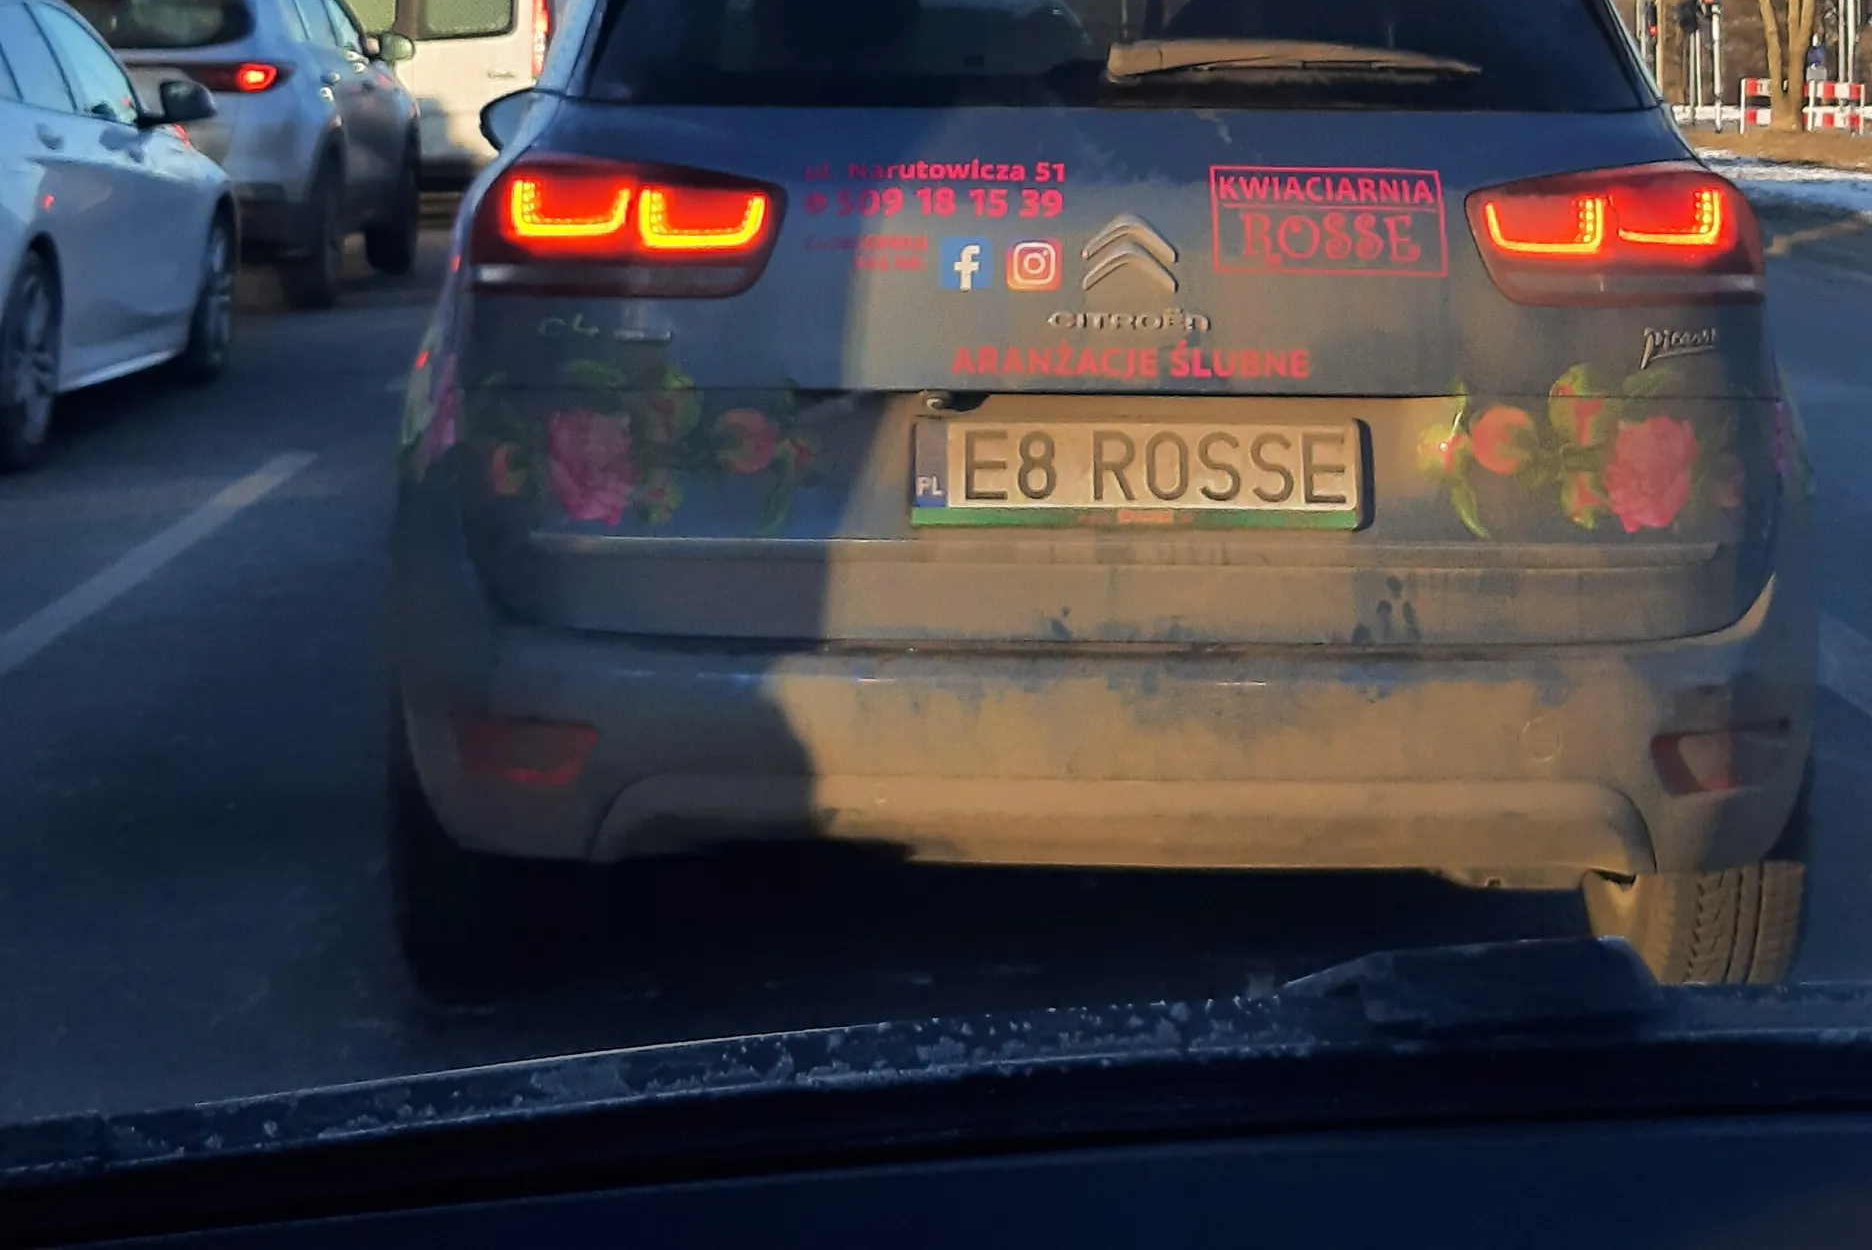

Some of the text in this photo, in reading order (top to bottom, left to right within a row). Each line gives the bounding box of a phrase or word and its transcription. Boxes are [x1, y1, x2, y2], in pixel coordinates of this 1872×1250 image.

[848, 158, 1026, 182] Narutowicza
[1035, 162, 1066, 183] 51
[916, 187, 957, 218] 18
[969, 188, 1009, 218] 15
[1019, 189, 1064, 219] 39
[1218, 174, 1435, 206] KWIACIARNIA
[1240, 211, 1421, 266] ROSSE
[953, 339, 1310, 379] ARANŻACJE ŚLUBNE
[963, 429, 1347, 504] E8 ROSSE
[916, 476, 942, 497] PL
